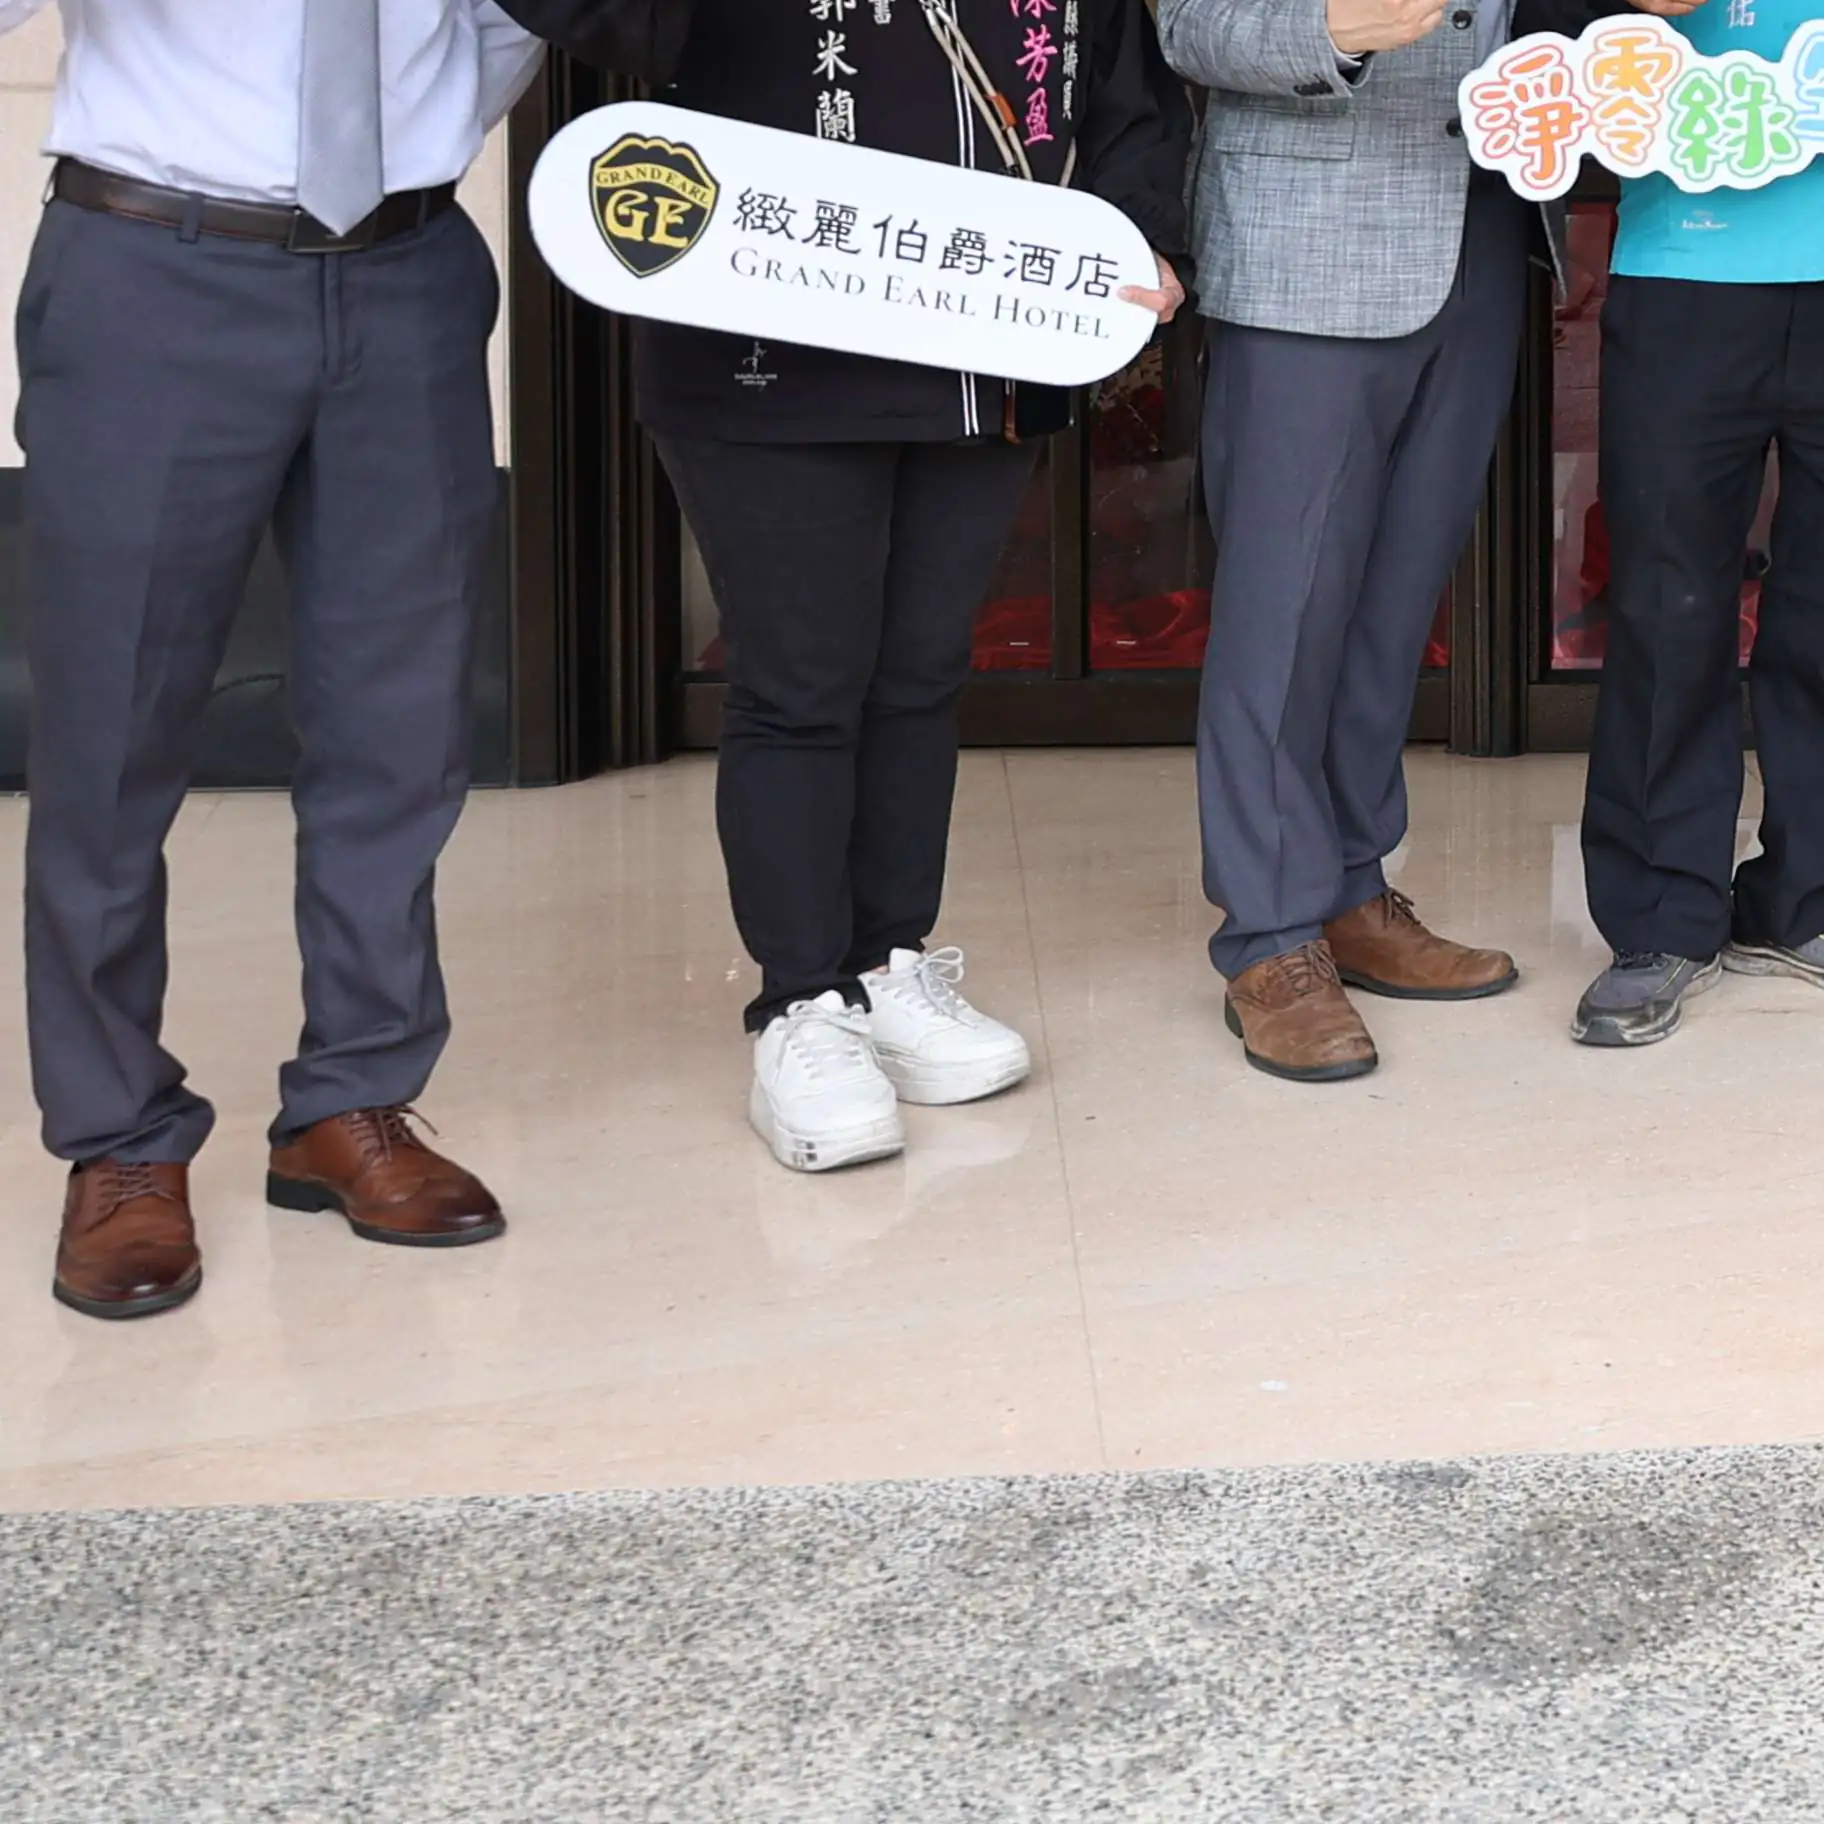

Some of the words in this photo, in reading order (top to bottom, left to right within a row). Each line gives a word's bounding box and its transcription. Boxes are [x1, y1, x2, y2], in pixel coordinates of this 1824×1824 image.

[597, 166, 663, 185] GRAND
[665, 174, 710, 206] EARL
[604, 188, 693, 249] GE
[733, 186, 1121, 300] 緻麗伯爵酒店
[730, 247, 866, 296] GRAND
[884, 274, 976, 317] EARL
[993, 294, 1110, 340] HOTEL
